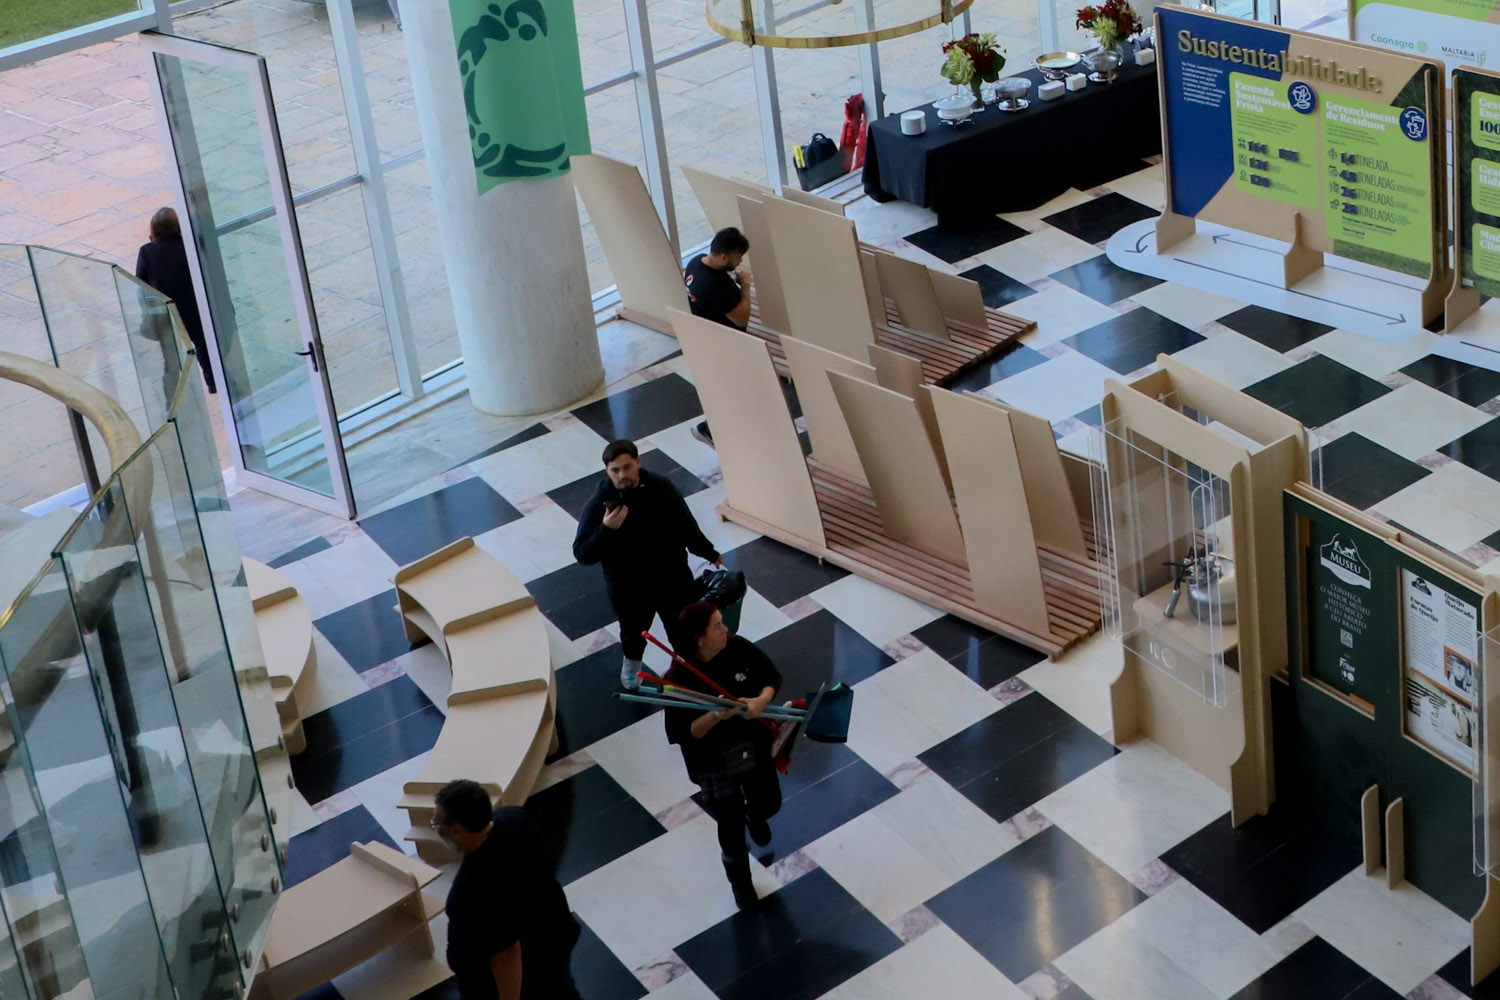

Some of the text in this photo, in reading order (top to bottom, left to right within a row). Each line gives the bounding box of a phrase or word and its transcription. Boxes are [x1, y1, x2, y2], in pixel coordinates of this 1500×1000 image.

[1371, 33, 1415, 50] Coonagro
[1177, 30, 1384, 94] Sustentabilidade
[1235, 80, 1274, 97] Fazenda
[1235, 90, 1292, 110] Sustentável
[1326, 110, 1339, 120] de
[1356, 154, 1389, 172] TONELADA
[1358, 172, 1395, 190] TONELADAS
[1358, 188, 1395, 208] TONELADAS
[1359, 205, 1395, 224] TONELADAS
[1330, 551, 1361, 574] MUSEU
[1327, 588, 1348, 604] MAIOR
[1349, 601, 1371, 616] MUSEU
[1330, 583, 1362, 605] CONHEÇA
[1410, 596, 1433, 613] Formas
